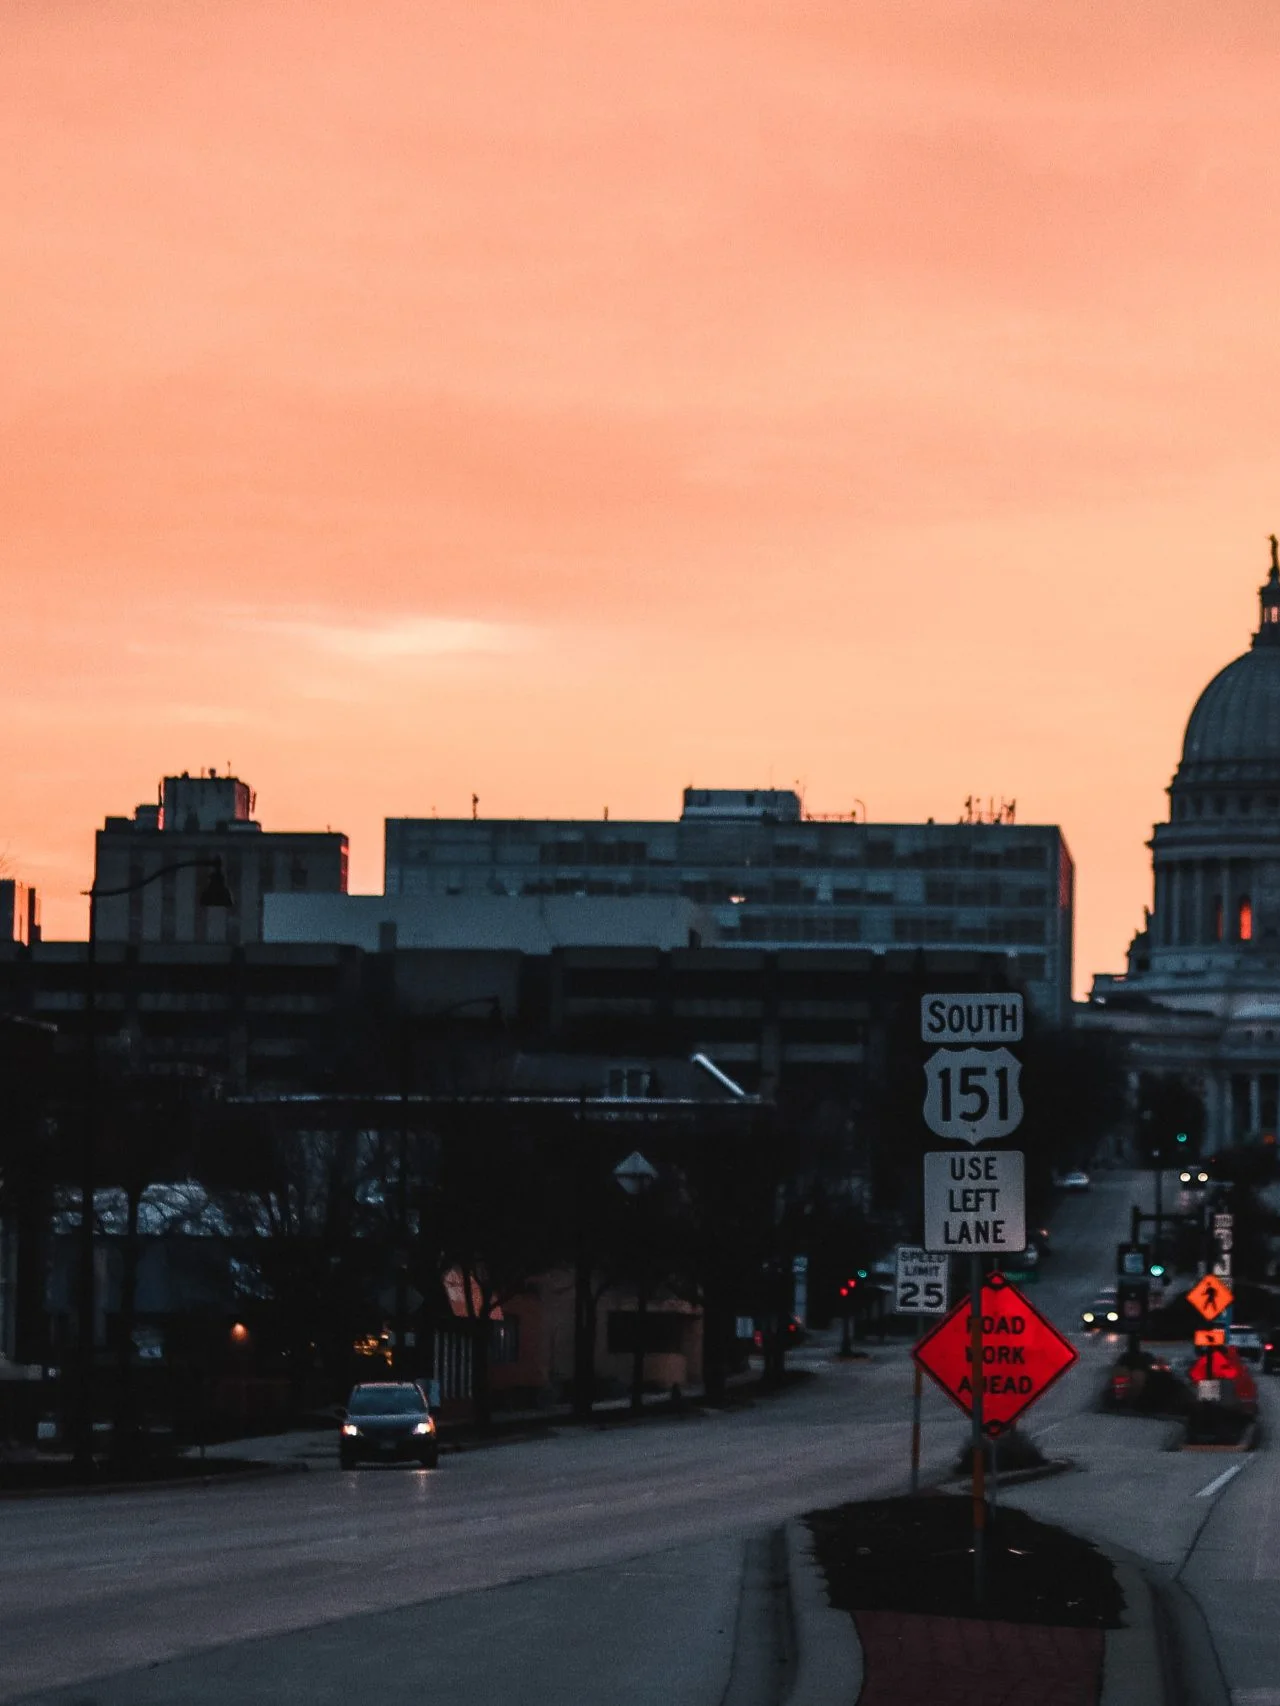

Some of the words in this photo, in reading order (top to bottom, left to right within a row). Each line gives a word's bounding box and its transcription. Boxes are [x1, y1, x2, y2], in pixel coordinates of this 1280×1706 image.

[928, 1000, 1017, 1033] SOUTH
[938, 1067, 1008, 1122] 151
[951, 1157, 997, 1180] USE
[949, 1189, 1000, 1212] LEFT
[944, 1220, 1005, 1244] LANE
[905, 1265, 939, 1276] LIMIT
[900, 1282, 943, 1308] 25
